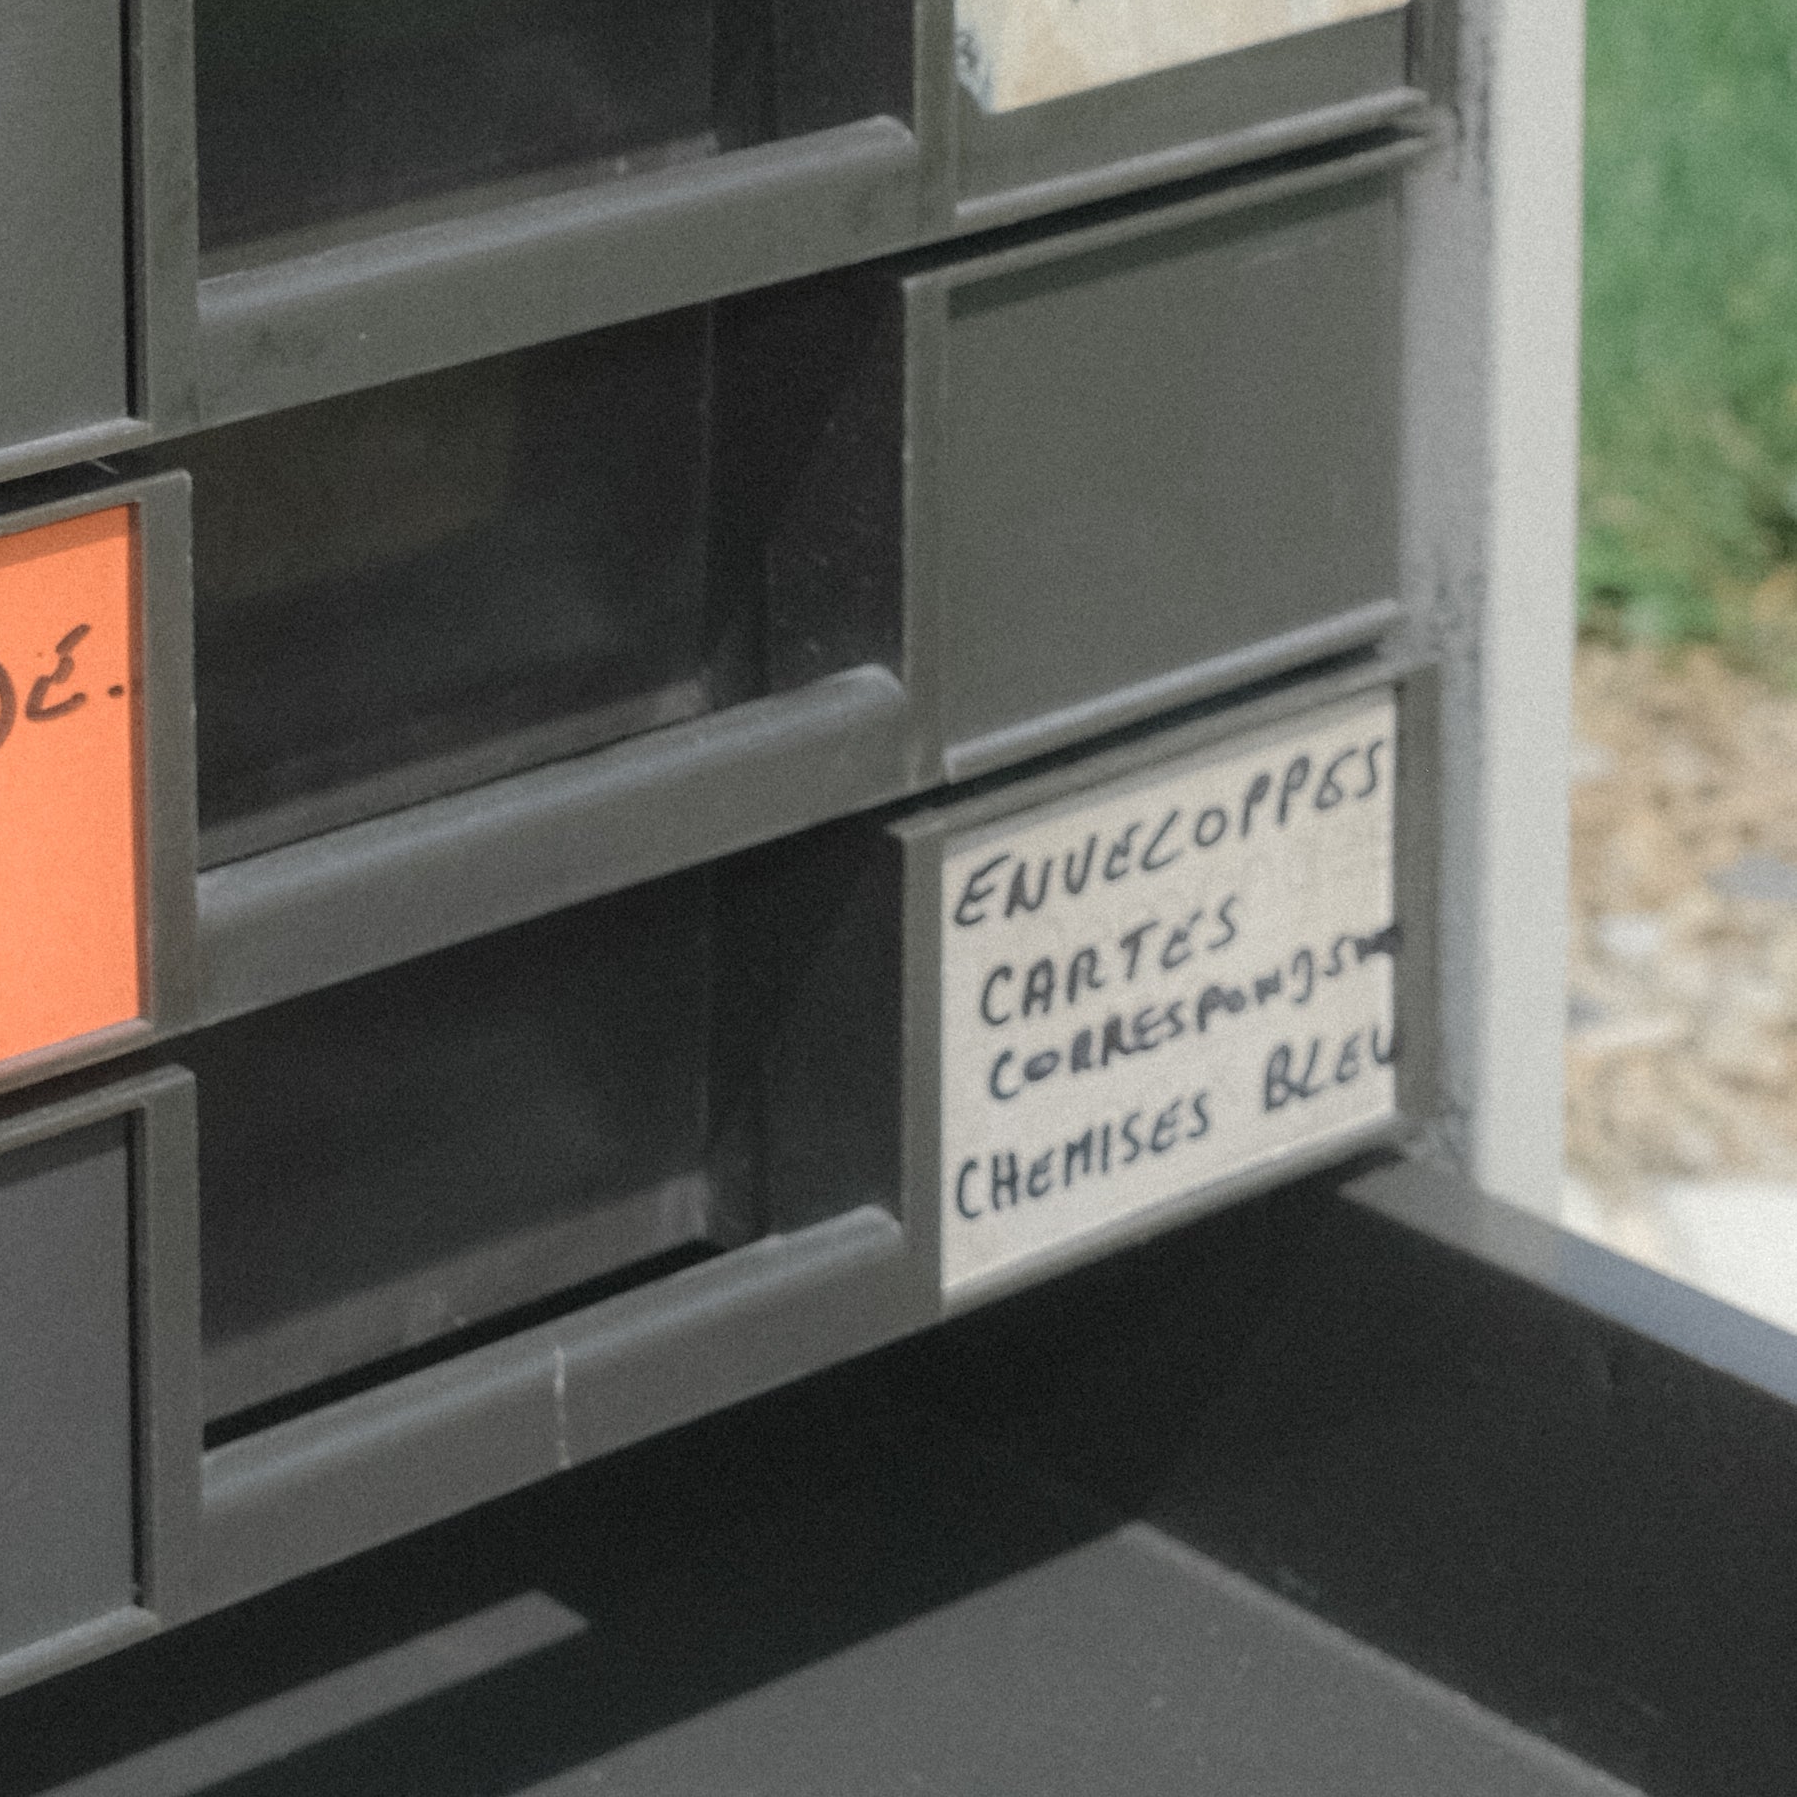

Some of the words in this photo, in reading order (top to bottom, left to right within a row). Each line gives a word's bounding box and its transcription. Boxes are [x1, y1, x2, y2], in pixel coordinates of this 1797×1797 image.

[952, 739, 1385, 929] ENVELOPPES
[978, 893, 1239, 1027] CARTES
[954, 1091, 1213, 1221] CHEMISES
